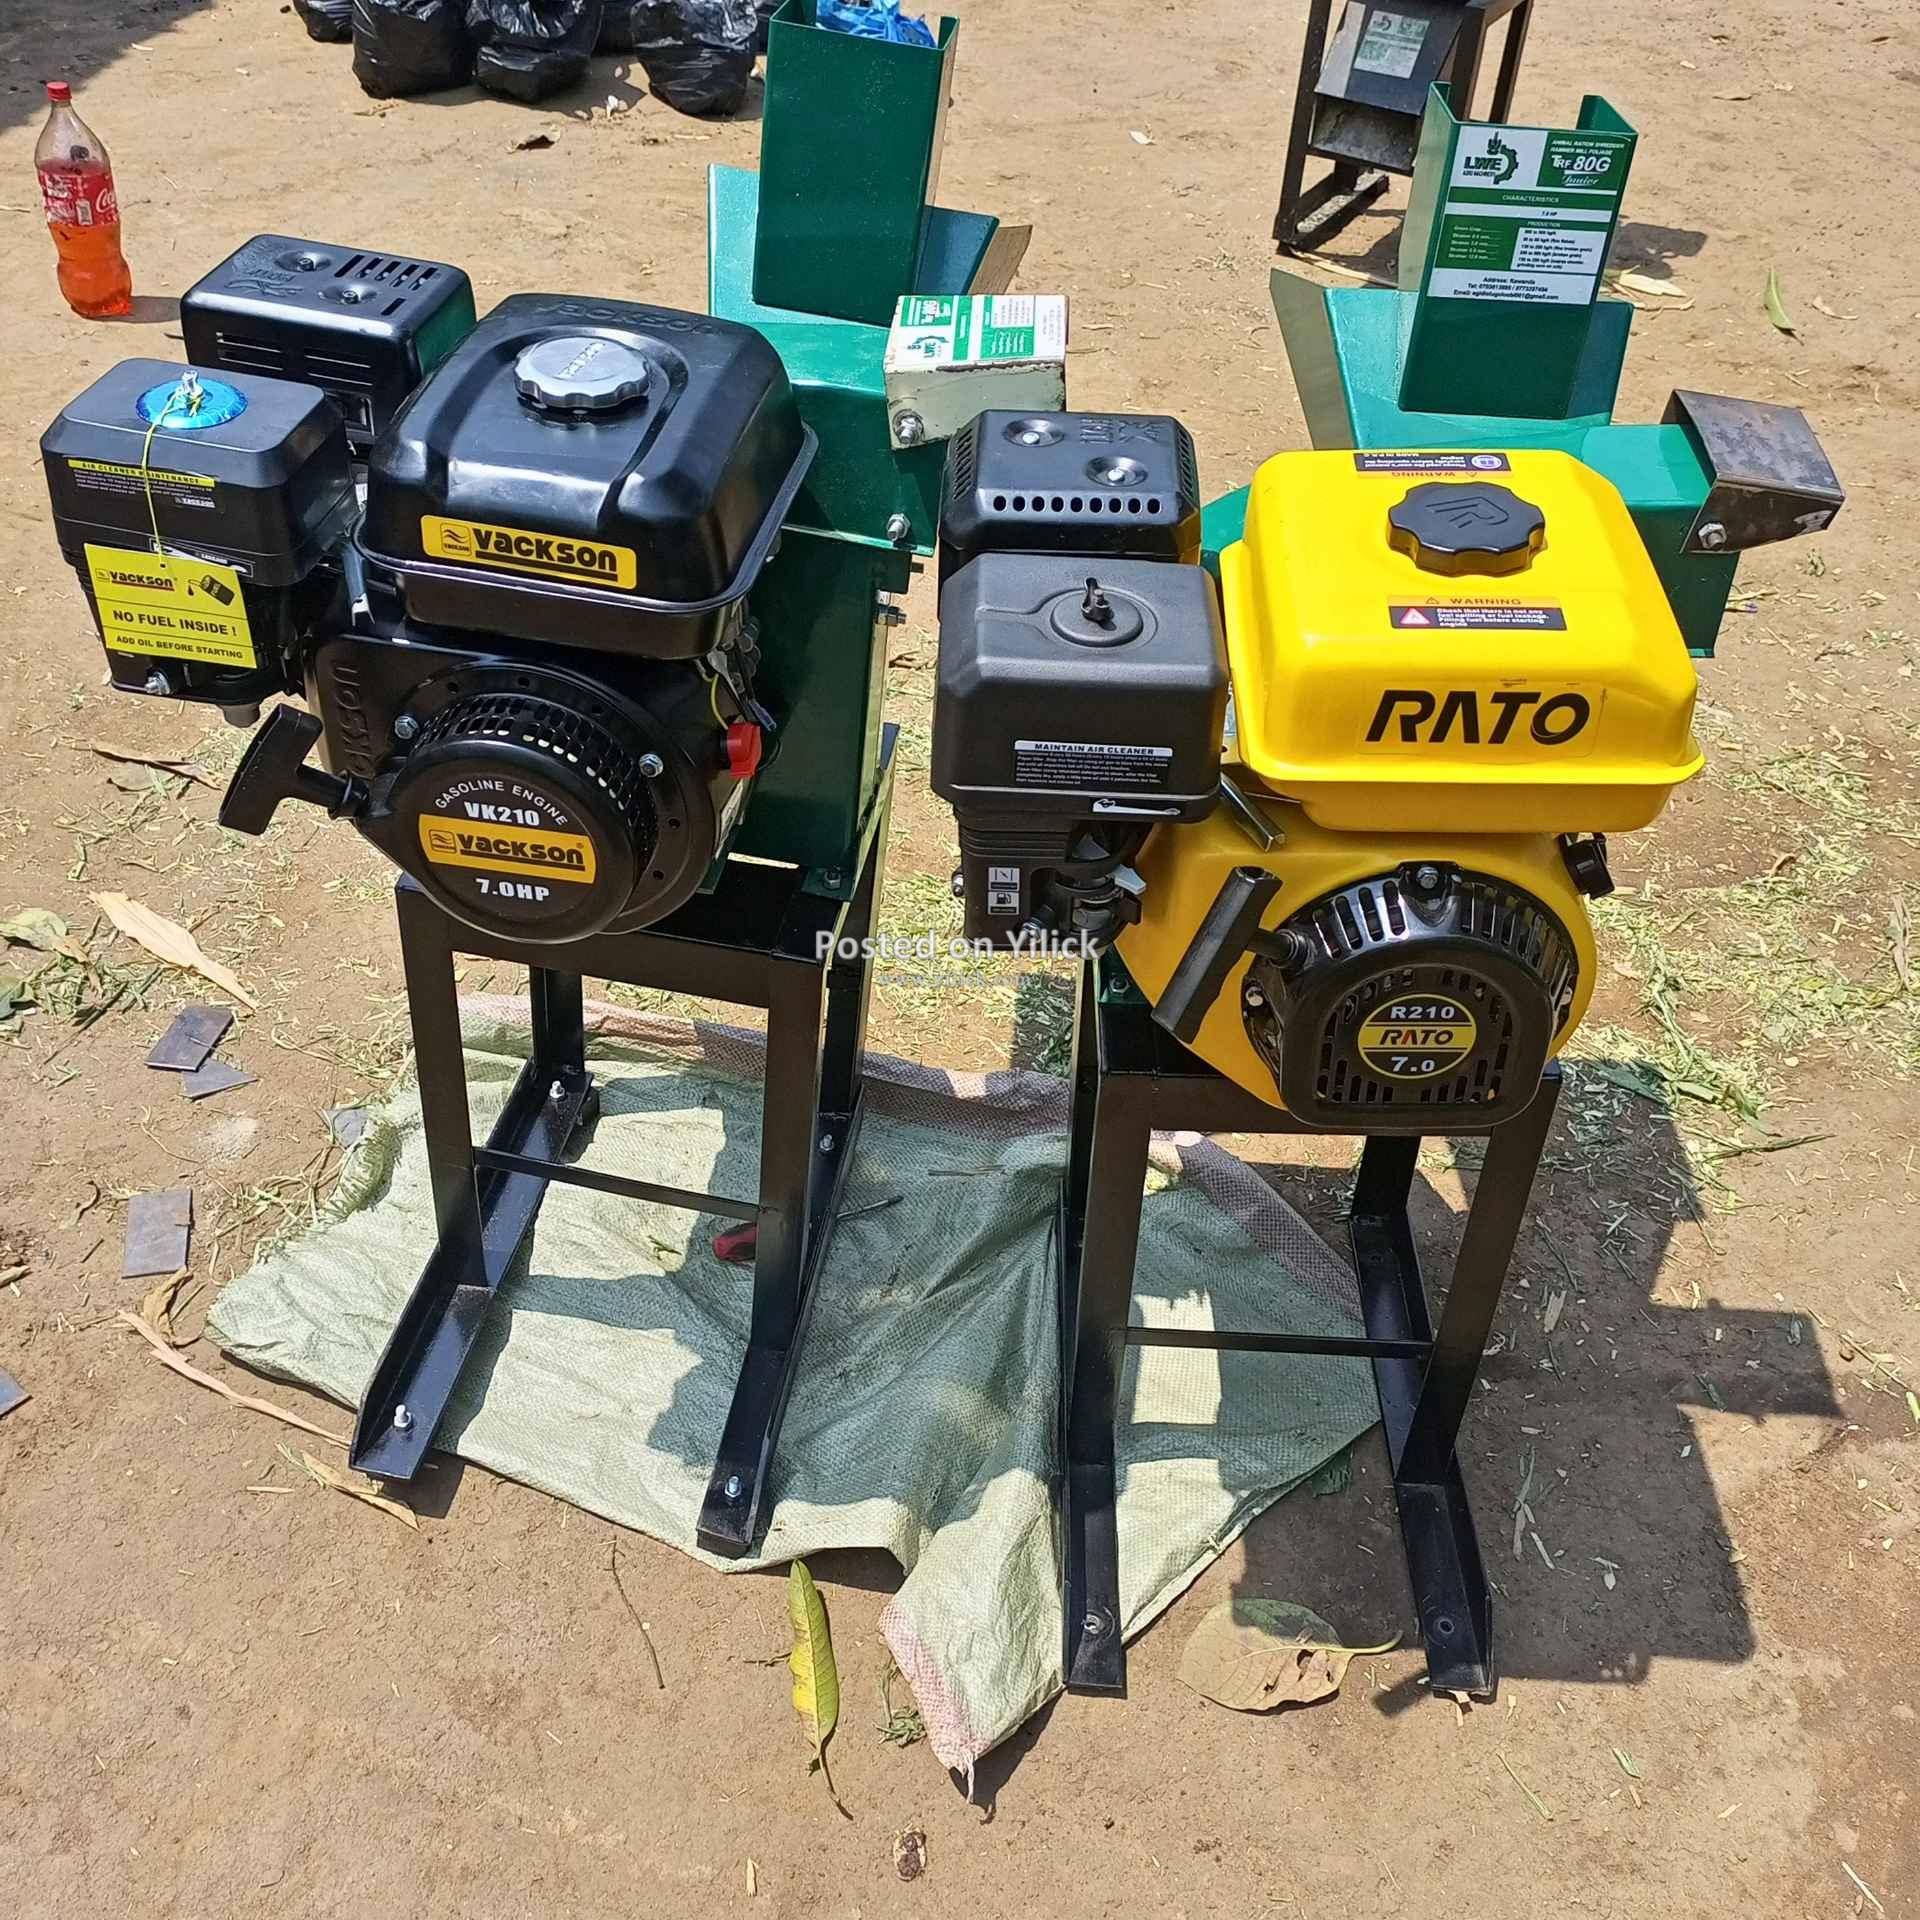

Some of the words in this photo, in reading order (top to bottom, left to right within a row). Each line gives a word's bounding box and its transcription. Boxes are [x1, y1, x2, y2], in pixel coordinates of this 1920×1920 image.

[1464, 156, 1502, 171] LWE
[1573, 155, 1612, 172] 80G
[1502, 194, 1559, 203] CHARACTERISTICS
[1449, 598, 1522, 606] WARNING
[113, 610, 134, 622] NO
[138, 613, 175, 628] FUEL
[179, 618, 228, 635] INSIDE
[116, 635, 135, 645] ADD
[138, 638, 153, 648] OIL
[156, 641, 194, 653] BEFORE
[195, 645, 244, 659] STARTING
[1365, 689, 1590, 745] RATO
[1034, 743, 1085, 753] MAINTAIN
[1087, 745, 1104, 754] AIR
[1107, 746, 1154, 756] CLEANER
[434, 779, 505, 809] GASOLINE
[511, 785, 569, 826] ENGINE
[463, 801, 540, 826] VK210
[475, 878, 550, 902] 7.0HP
[1390, 1004, 1456, 1022] R210
[1378, 1028, 1455, 1046] RATO
[1391, 1056, 1436, 1074] 7.0
